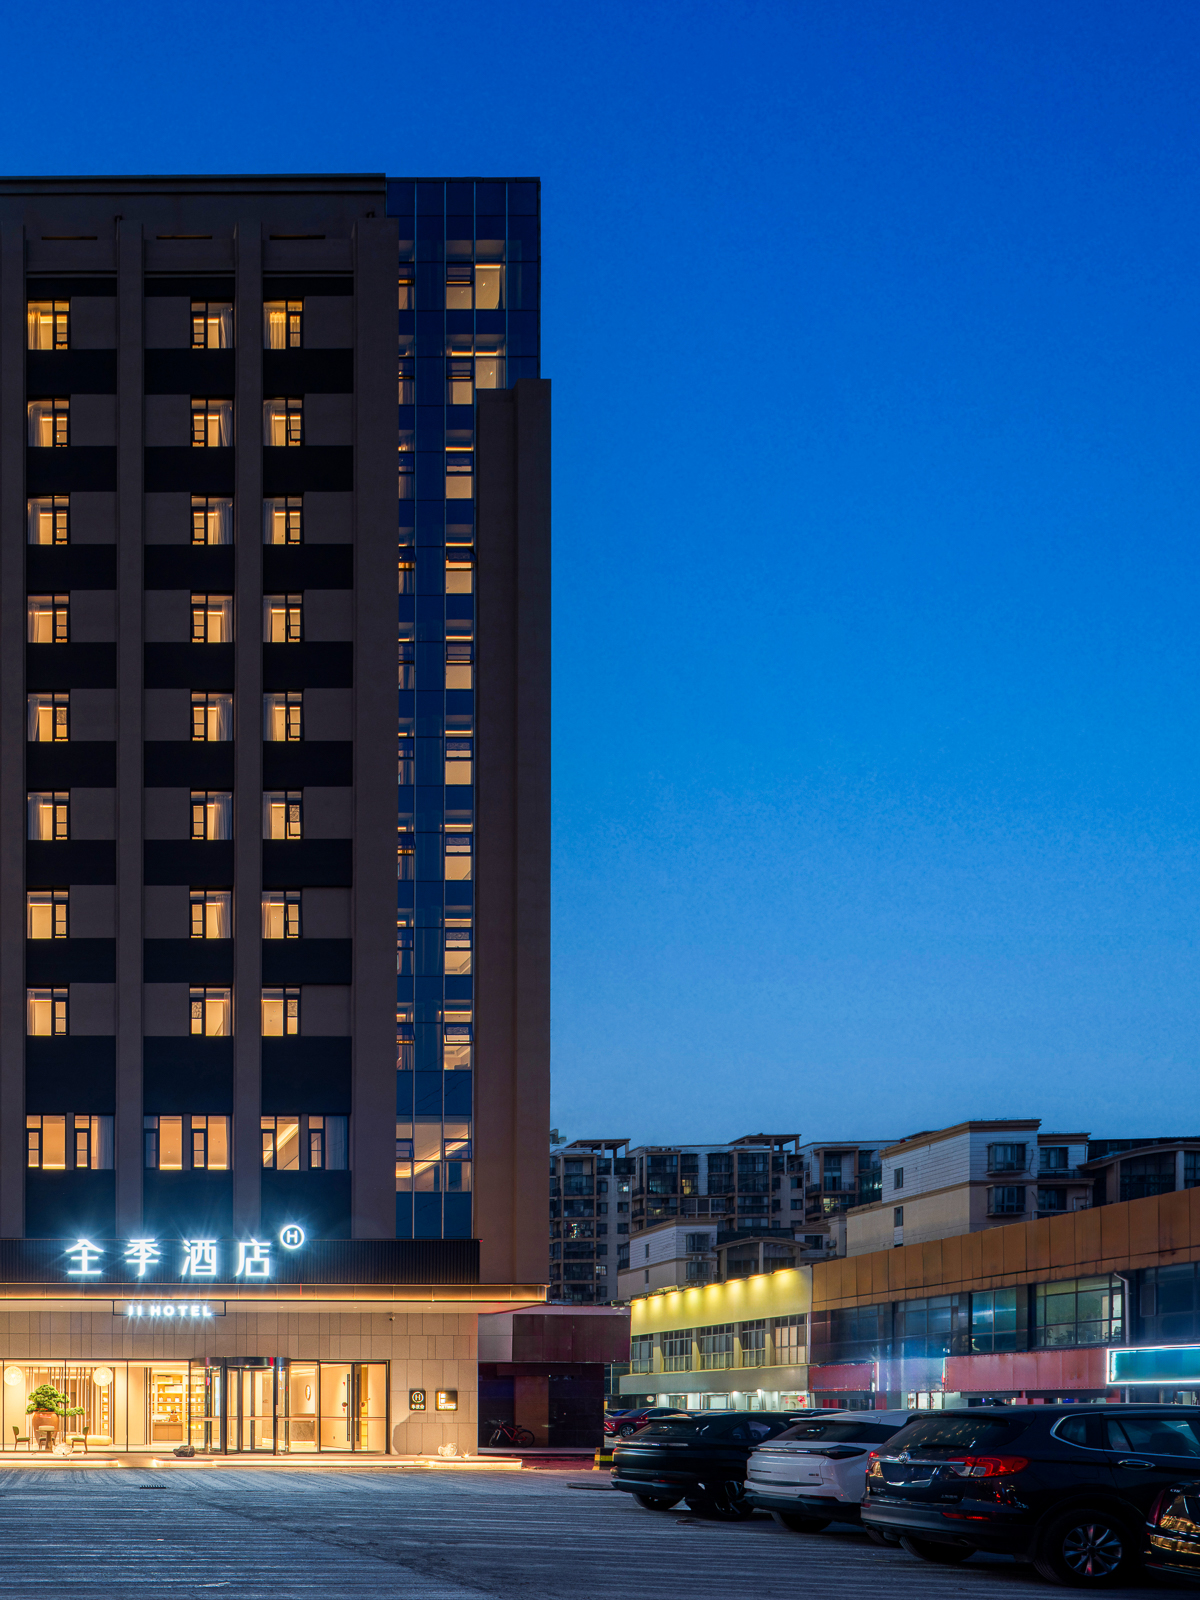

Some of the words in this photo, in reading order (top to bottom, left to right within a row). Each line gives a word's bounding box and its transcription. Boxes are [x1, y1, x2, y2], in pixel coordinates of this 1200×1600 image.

[65, 1238, 272, 1277] 全季酒店
[150, 1304, 212, 1317] HOTEL
